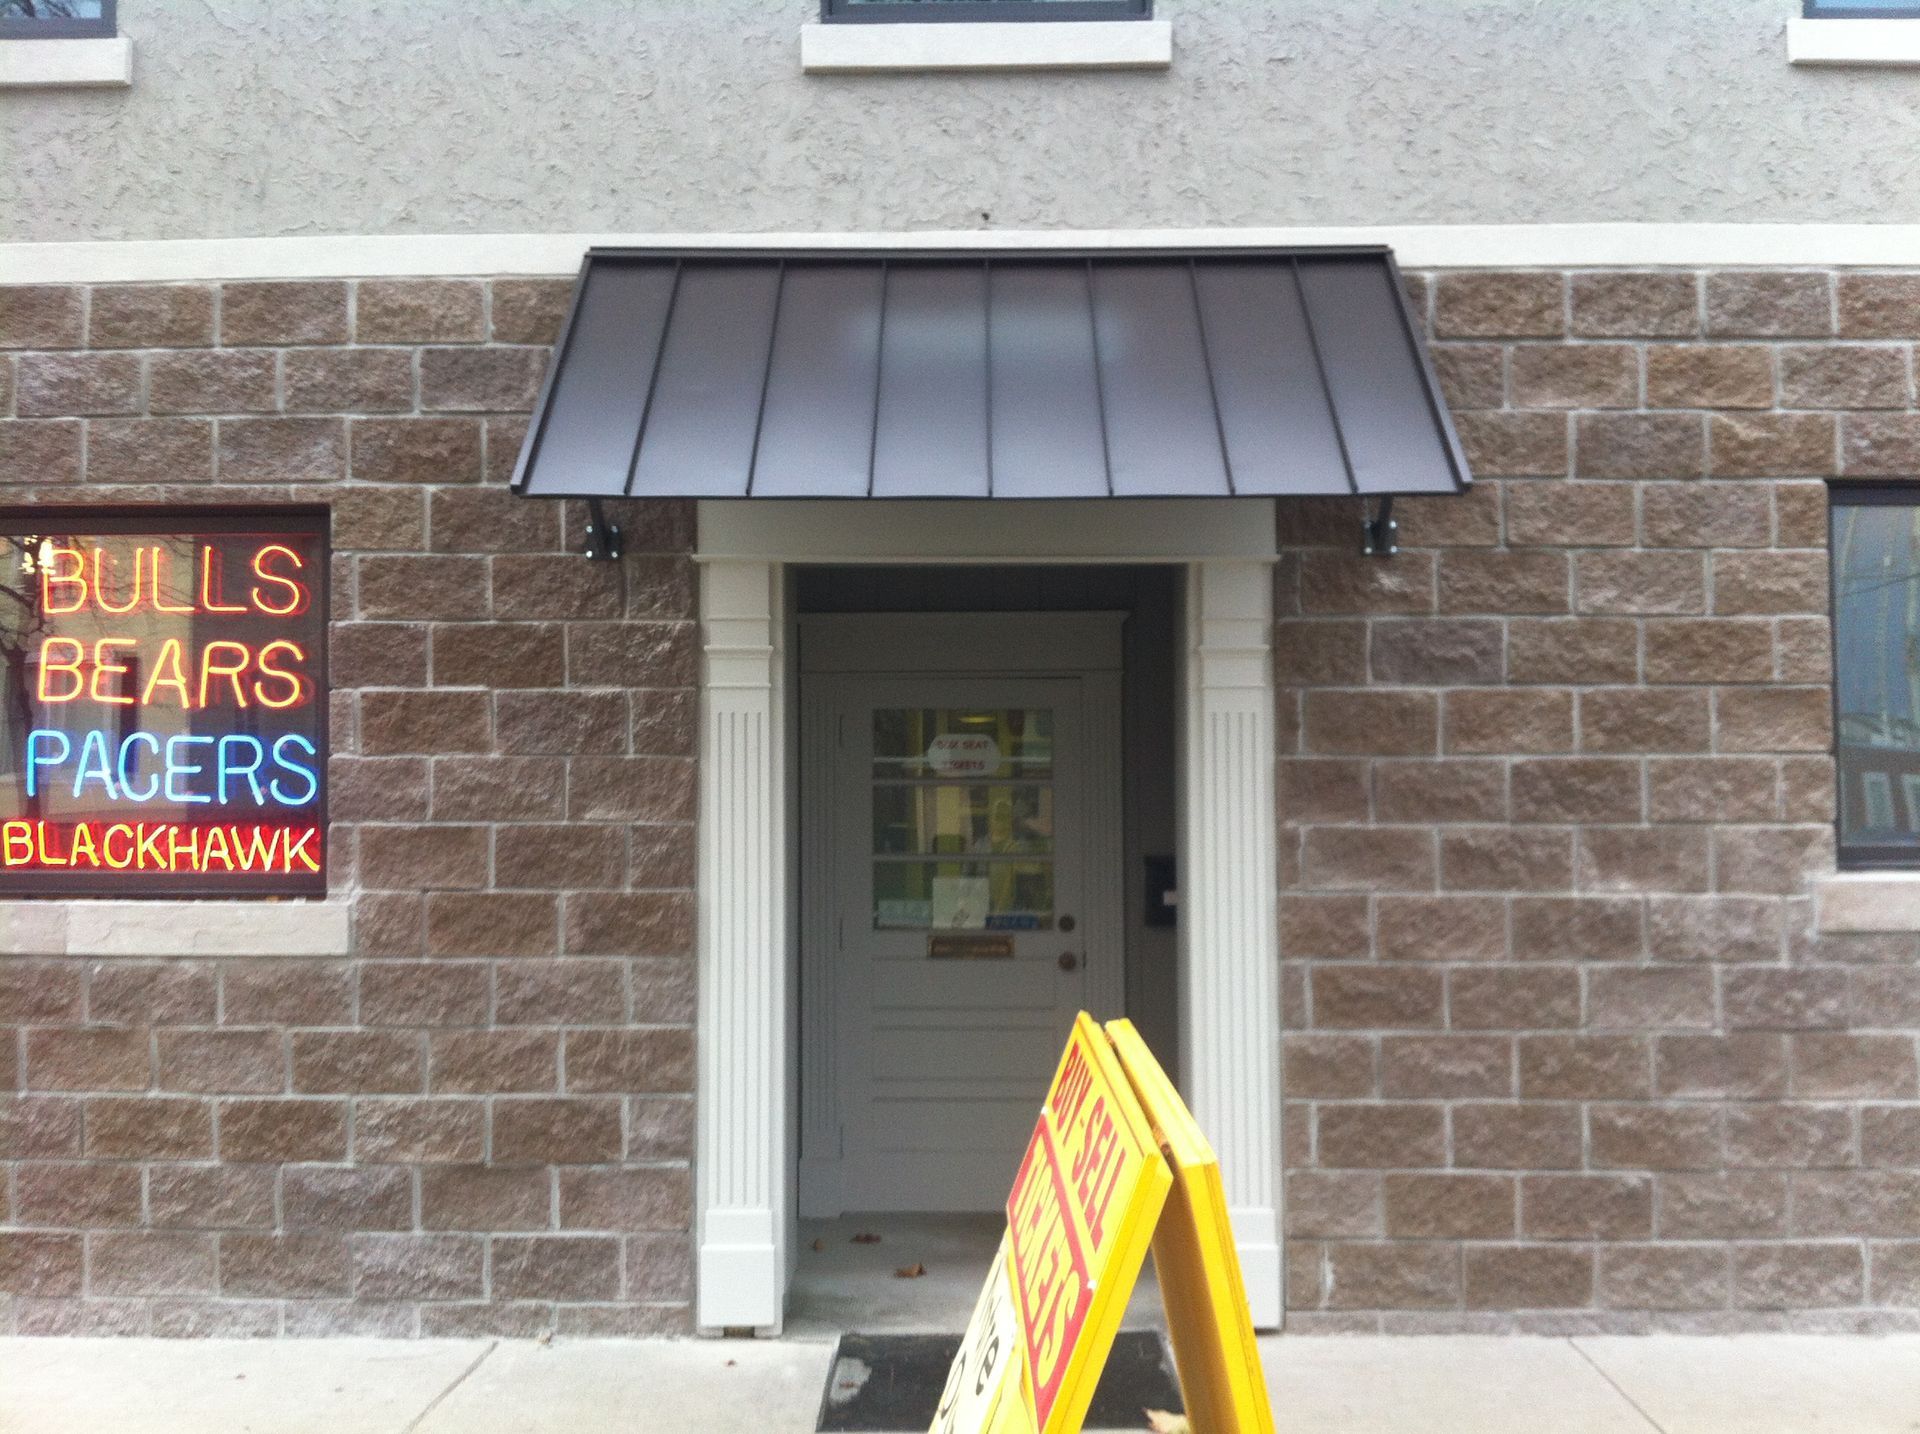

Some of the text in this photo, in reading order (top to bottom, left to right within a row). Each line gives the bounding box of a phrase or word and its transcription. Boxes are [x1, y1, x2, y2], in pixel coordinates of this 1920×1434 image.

[42, 545, 303, 615] BULLS
[37, 638, 304, 709] BEARS
[26, 729, 319, 806] PACERS
[2, 820, 321, 873] BLACKHAWK
[1013, 1135, 1081, 1390] TICKETS
